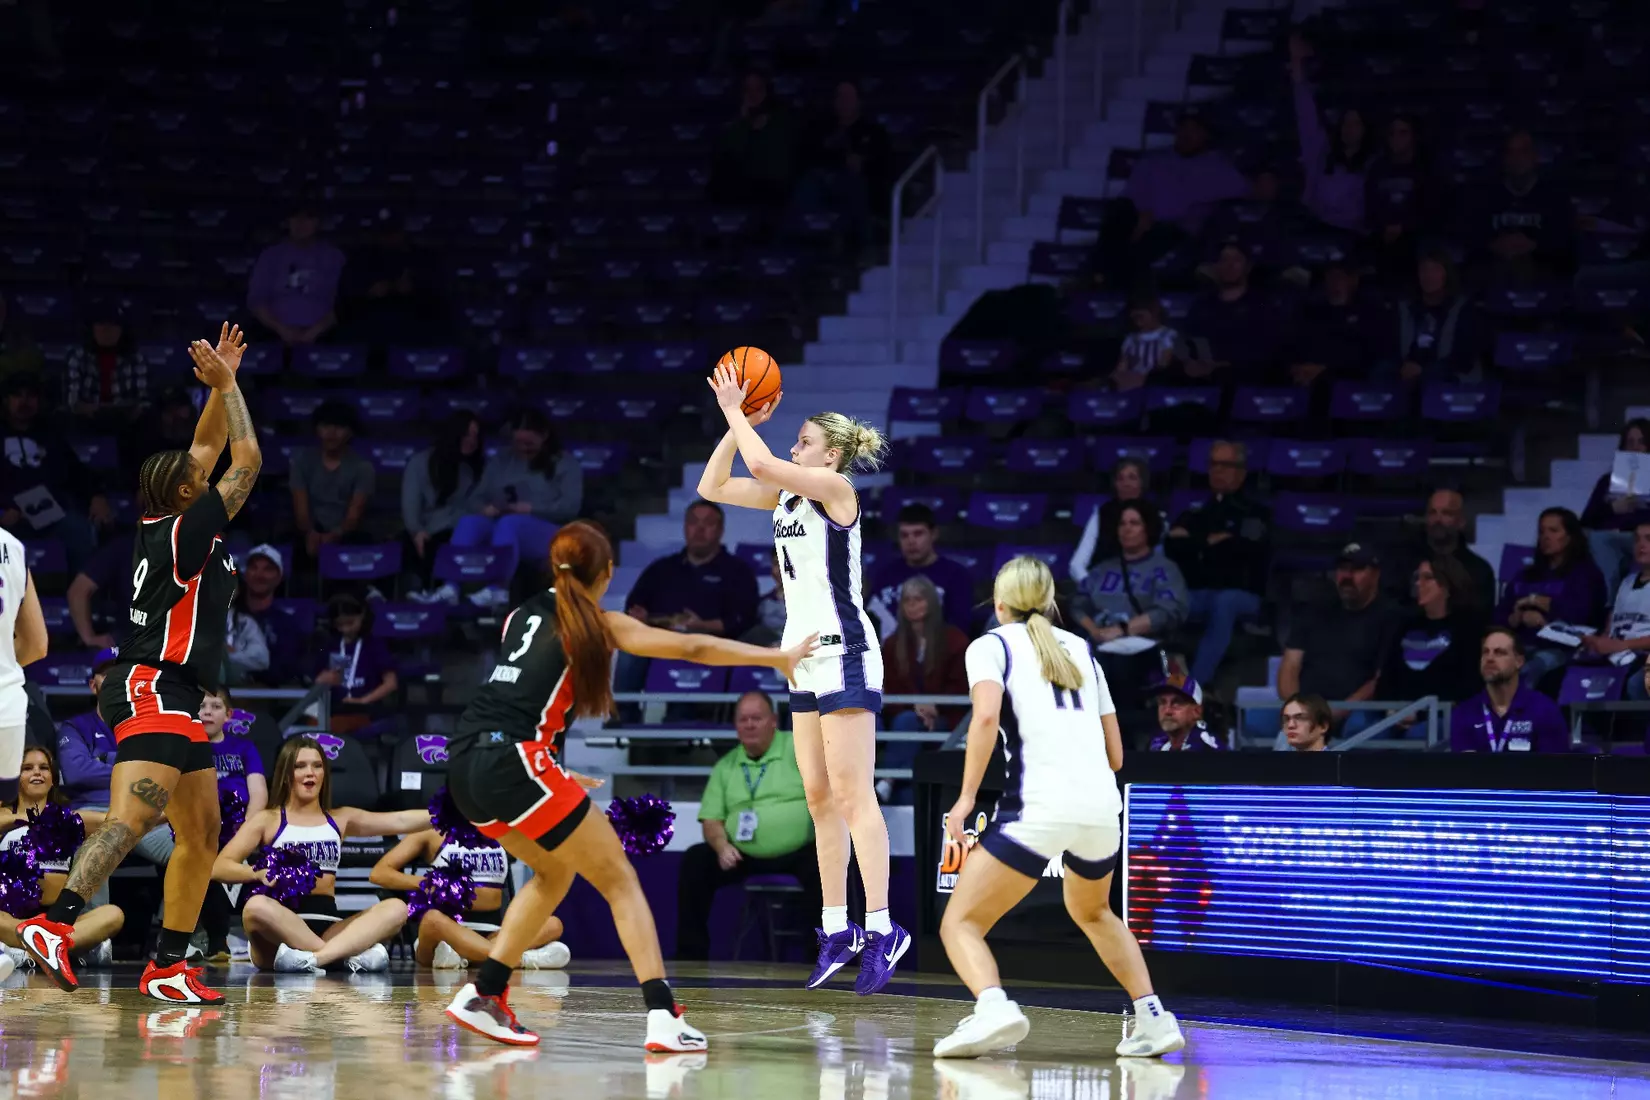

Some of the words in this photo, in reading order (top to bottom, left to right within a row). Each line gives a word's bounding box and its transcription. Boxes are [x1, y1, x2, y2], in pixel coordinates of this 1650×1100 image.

[133, 558, 148, 601] 9
[782, 544, 796, 580] 4
[508, 615, 542, 662] 3
